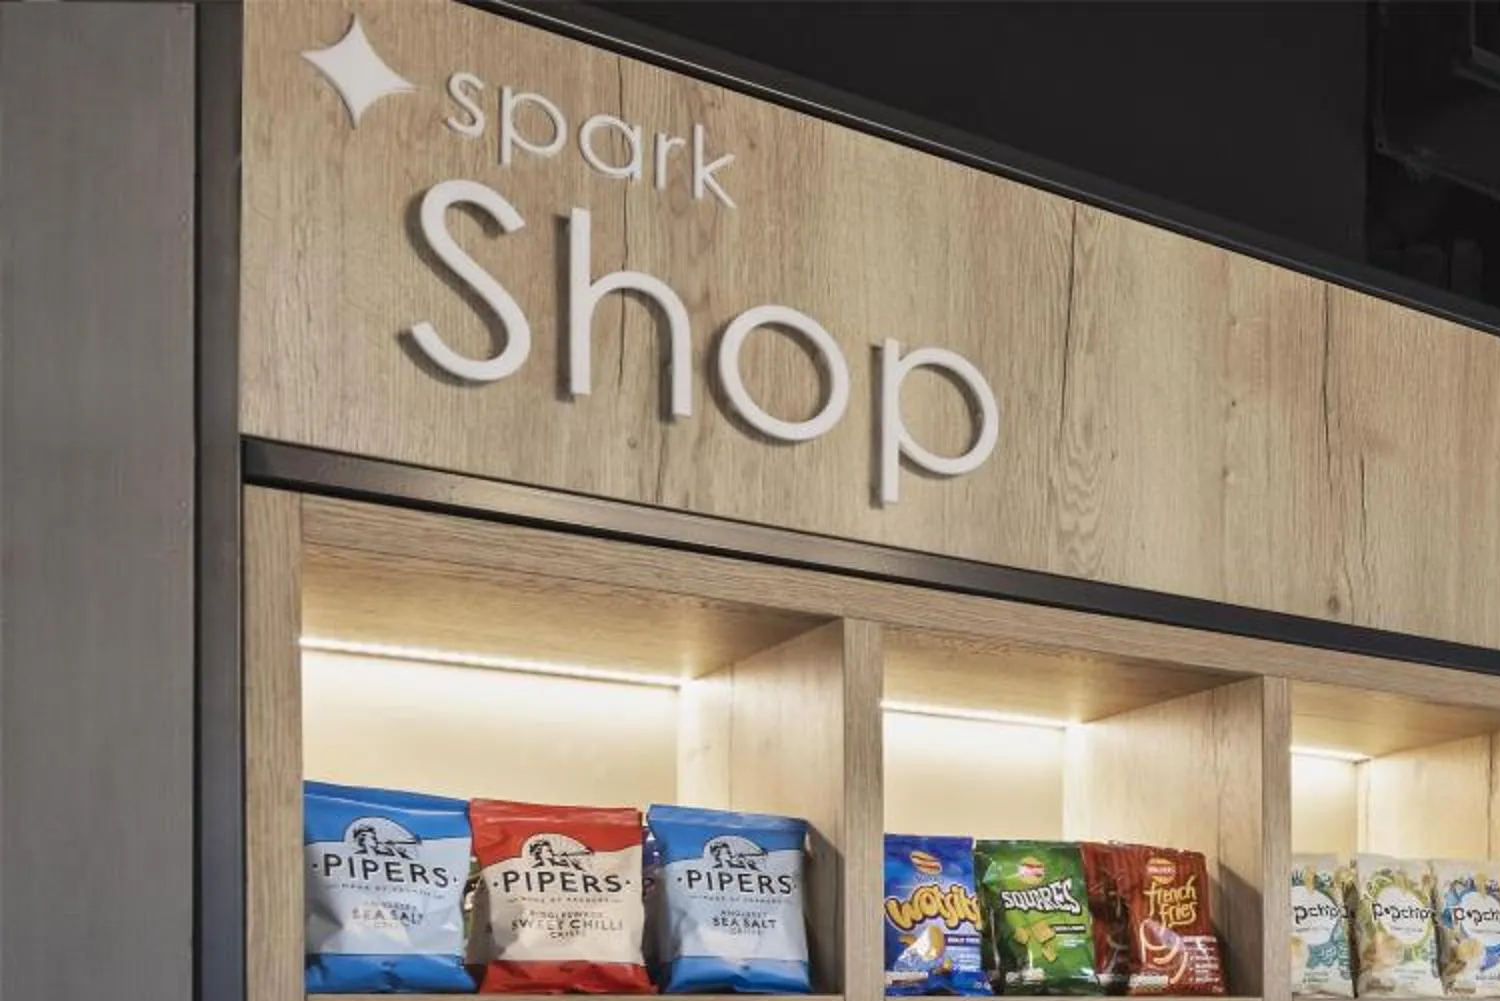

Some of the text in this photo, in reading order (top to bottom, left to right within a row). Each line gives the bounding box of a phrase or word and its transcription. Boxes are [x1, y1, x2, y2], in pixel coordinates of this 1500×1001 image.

[444, 70, 737, 209] spark
[410, 178, 999, 505] Shop
[324, 853, 449, 888] PIPERS
[503, 871, 622, 893] PIPERS
[686, 869, 791, 894] PIPERS
[712, 917, 777, 929] SEA SALT
